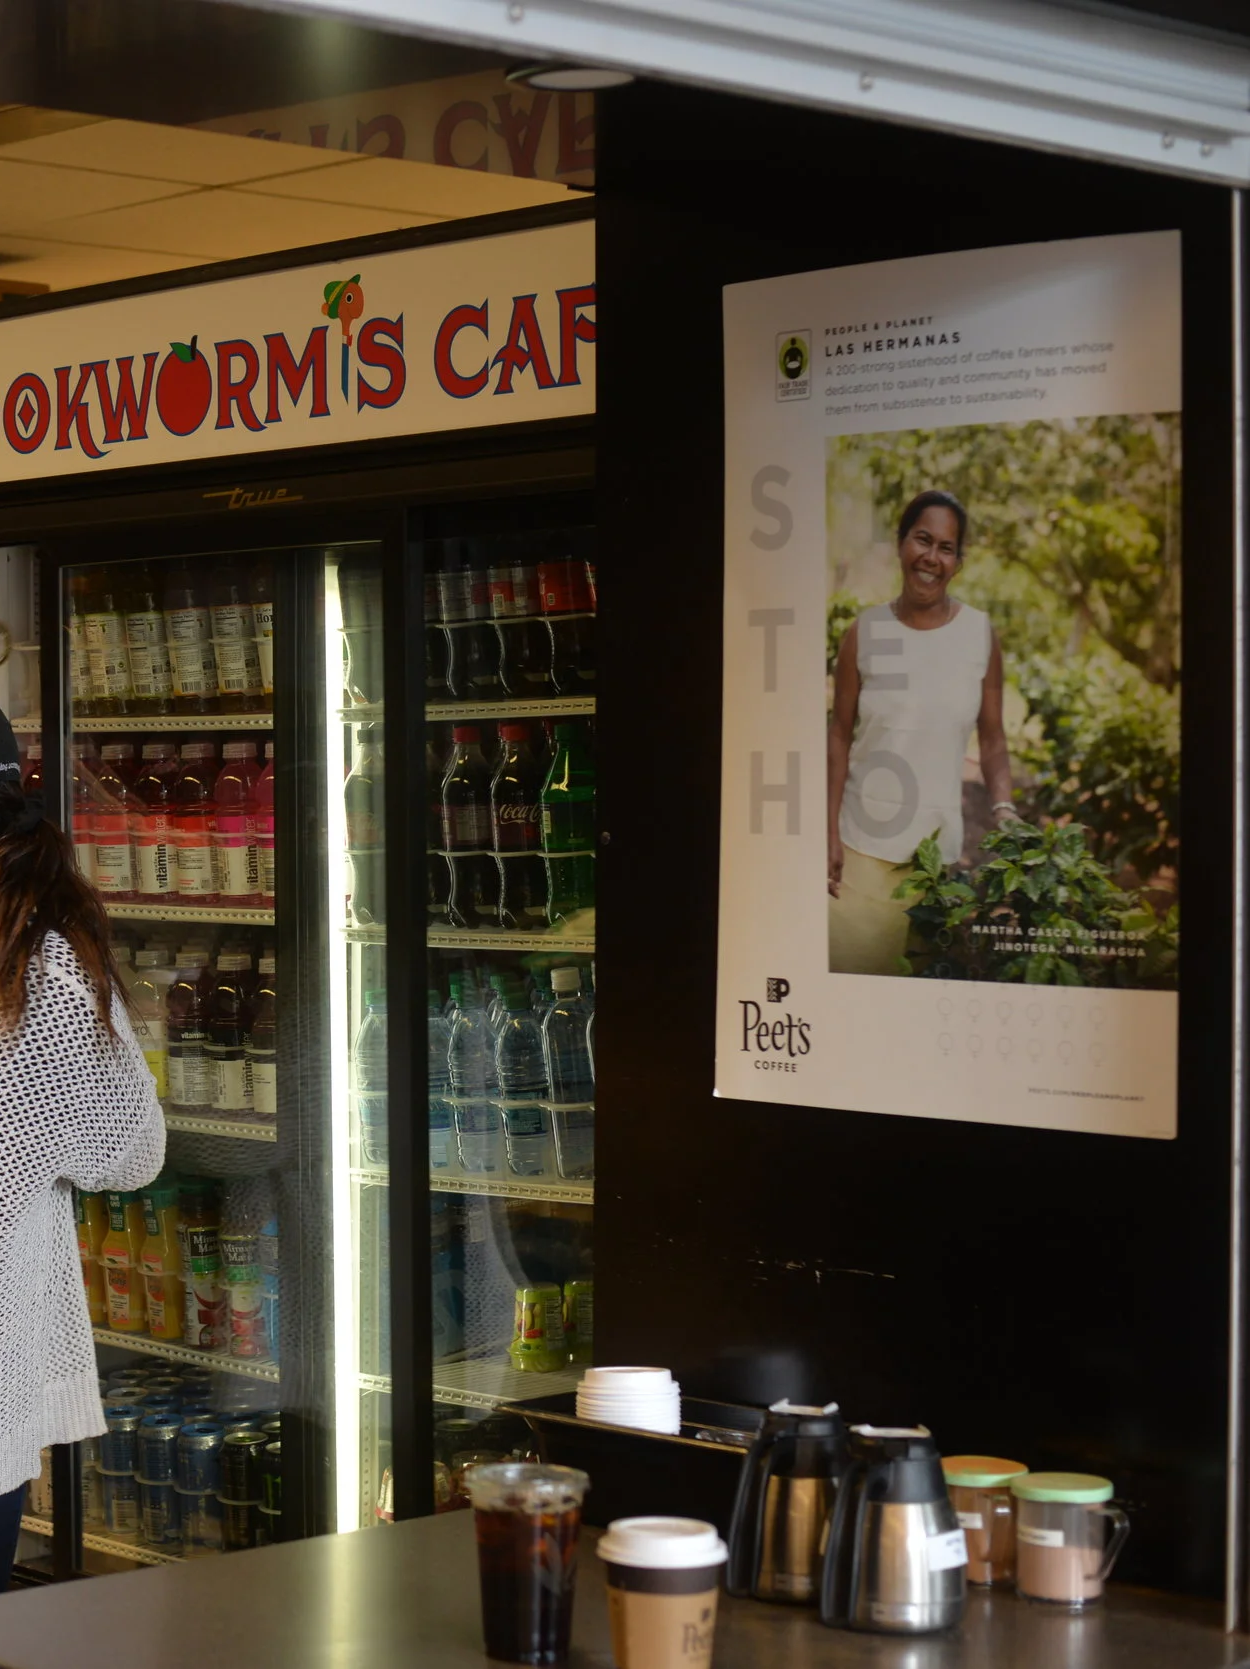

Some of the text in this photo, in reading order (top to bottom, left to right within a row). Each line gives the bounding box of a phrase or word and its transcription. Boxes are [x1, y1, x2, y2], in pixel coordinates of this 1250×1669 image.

[825, 316, 934, 336] PEOPLE & PLANET
[825, 331, 962, 357] LAS HERMANAS
[825, 340, 1115, 377] A 200-strong sisterhood of coffee farmers whose
[825, 361, 1107, 397] dedication to quality and community has moved
[825, 402, 852, 417] them
[853, 400, 880, 415] from
[882, 394, 947, 412] subsistence
[949, 393, 962, 405] to
[971, 924, 1024, 936] MARTHA
[1027, 926, 1072, 938] CASCO
[1065, 944, 1147, 957] NICARAGUA
[738, 1000, 811, 1057] Peet's
[754, 1060, 798, 1073] COFFEE
